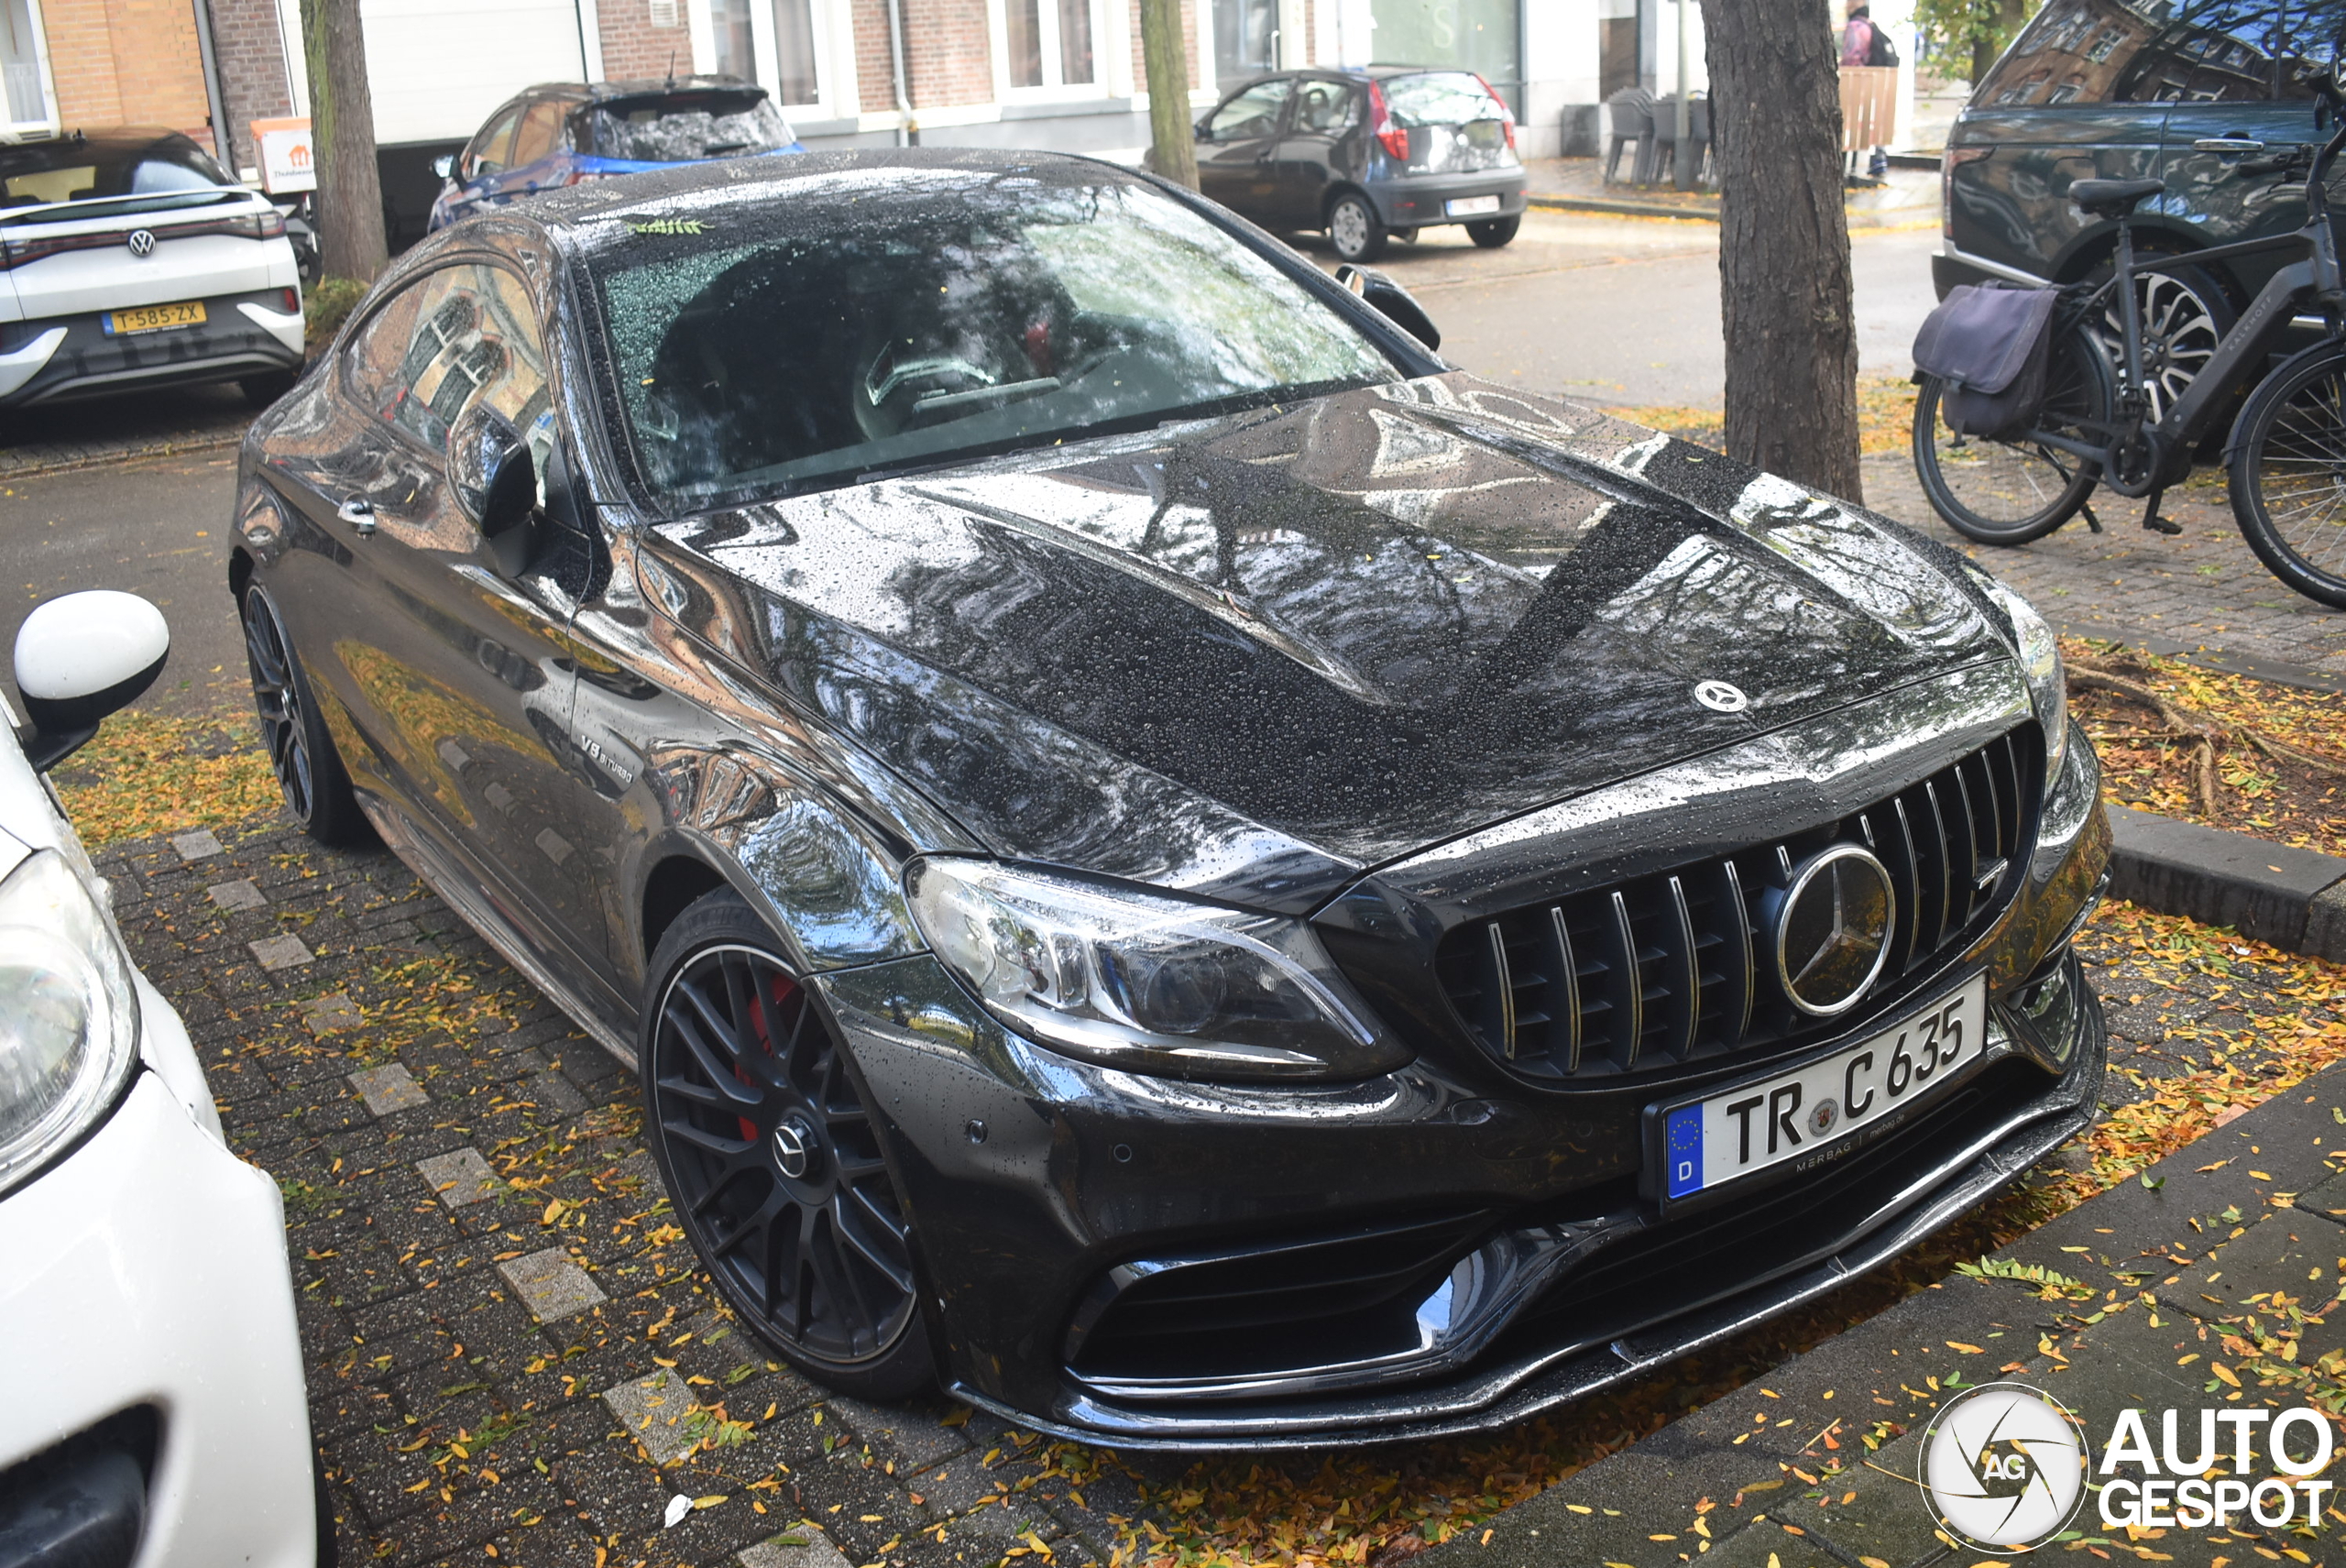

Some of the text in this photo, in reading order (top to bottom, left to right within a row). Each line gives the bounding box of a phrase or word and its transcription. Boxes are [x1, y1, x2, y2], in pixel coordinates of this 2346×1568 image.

[117, 304, 198, 329] T-585-ZX
[2228, 294, 2272, 351] KALKHOFF
[581, 734, 633, 784] V8 BITURBO
[1726, 1081, 1803, 1165] TR
[1844, 1049, 1875, 1119] C
[1887, 994, 1965, 1097] 635
[1796, 1142, 1851, 1172] MERBAG
[1869, 1113, 1905, 1139] merbag.de
[1679, 1160, 1692, 1181] D
